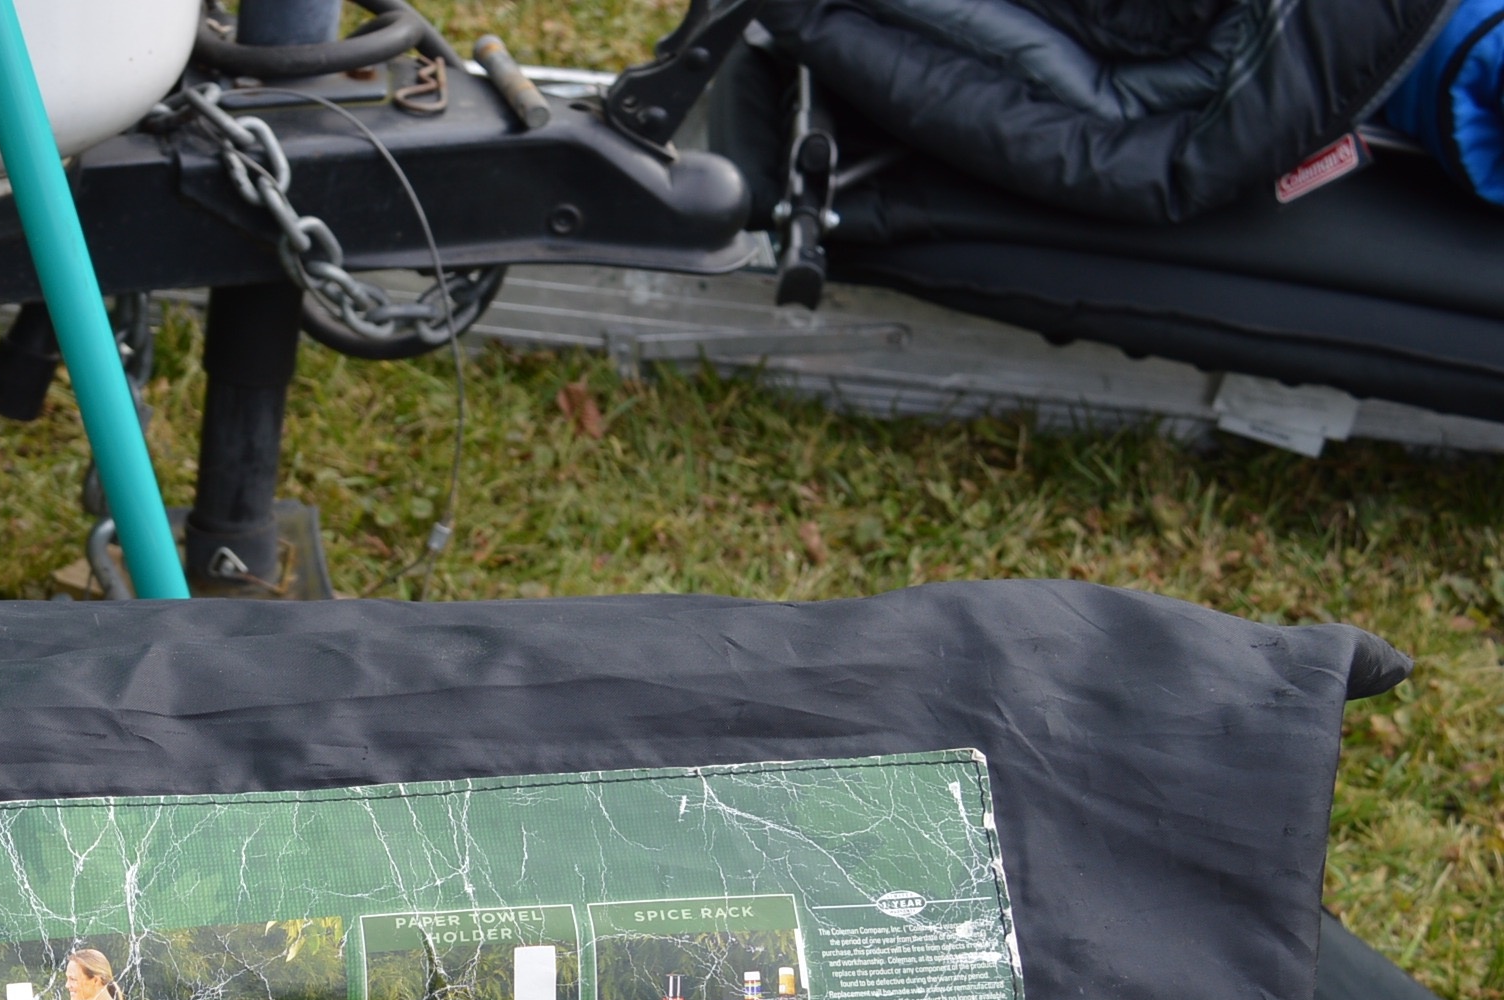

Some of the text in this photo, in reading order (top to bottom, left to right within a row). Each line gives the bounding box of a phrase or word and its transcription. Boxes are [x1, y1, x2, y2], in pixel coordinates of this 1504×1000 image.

[892, 899, 922, 908] YEAR
[395, 910, 543, 929] PAPER TOWEL
[634, 906, 754, 922] SPICE RACK
[429, 928, 513, 944] HOLDER
[817, 928, 830, 936] The
[831, 926, 858, 936] Coleman
[841, 937, 860, 946] period
[866, 946, 889, 956] product
[832, 968, 855, 978] replace
[856, 968, 868, 976] this
[869, 966, 893, 976] product
[902, 966, 914, 974] any
[914, 964, 950, 973] component
[840, 979, 858, 987] found
[866, 978, 874, 986] be
[876, 976, 904, 985] defective
[905, 975, 926, 985] during
[967, 971, 989, 981] period.
[828, 988, 870, 1000] Replacement
